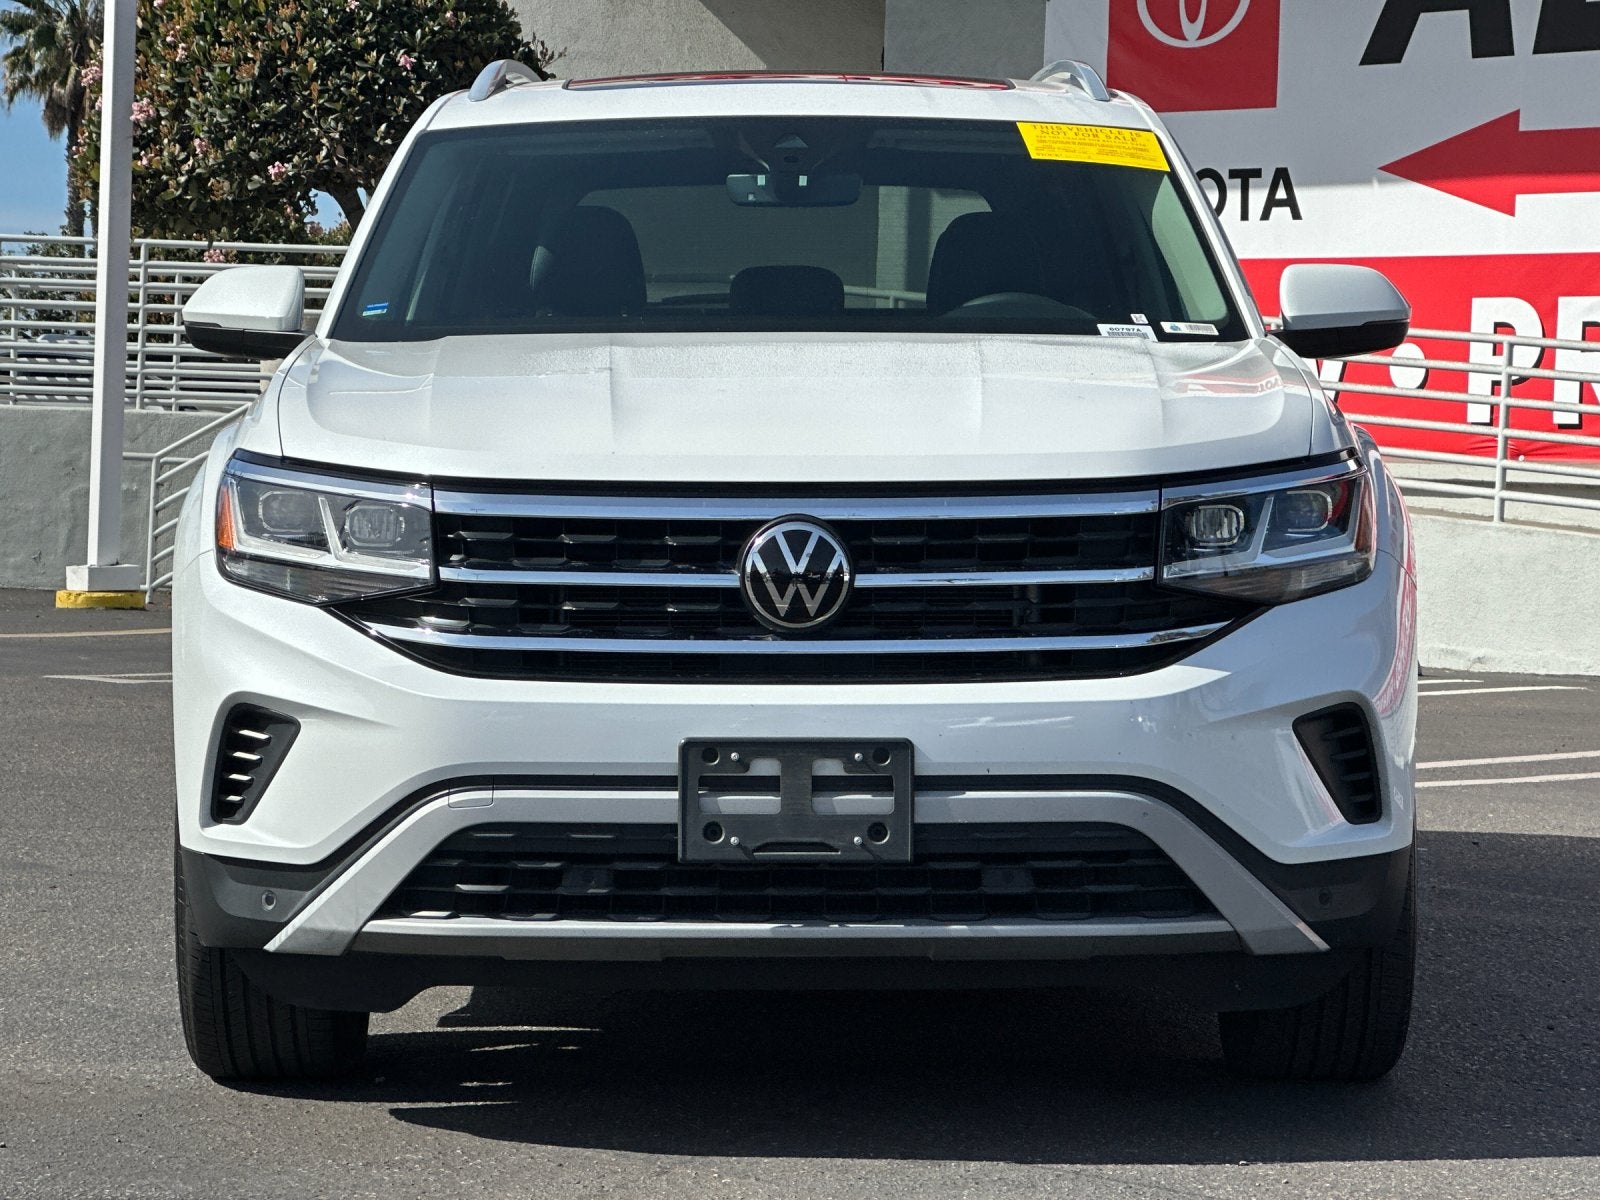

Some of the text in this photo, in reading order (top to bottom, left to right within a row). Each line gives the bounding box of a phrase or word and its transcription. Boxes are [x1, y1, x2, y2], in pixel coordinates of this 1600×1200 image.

[1067, 126, 1124, 136] VEHICLE
[1074, 131, 1100, 139] FOR
[1105, 134, 1138, 142] SALE
[750, 526, 846, 619] VW
